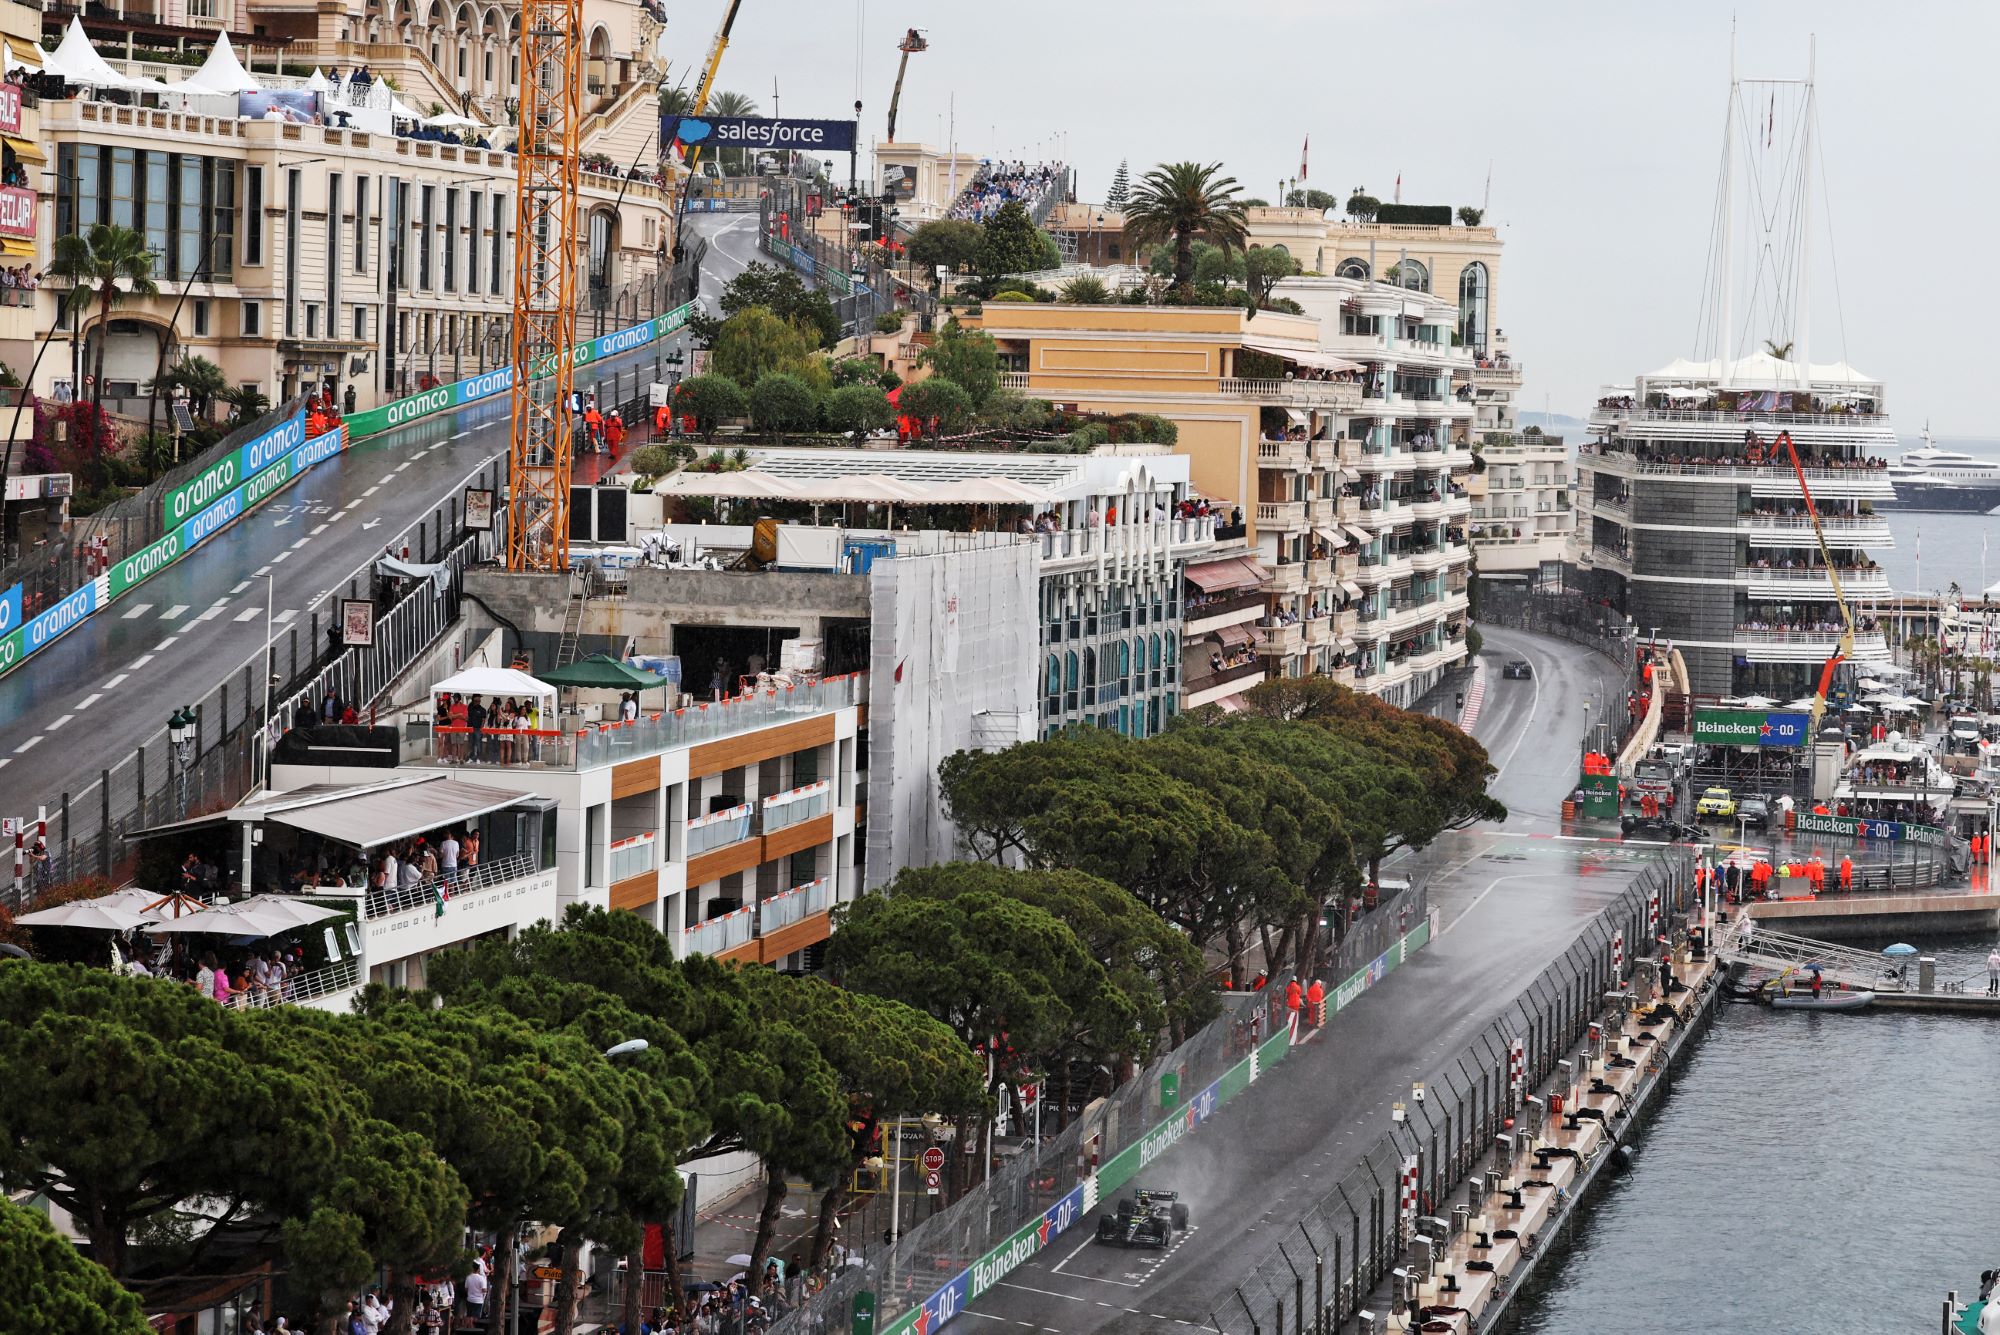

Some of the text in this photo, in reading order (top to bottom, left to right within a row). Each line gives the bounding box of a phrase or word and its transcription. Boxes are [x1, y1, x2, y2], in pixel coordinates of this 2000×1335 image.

[717, 121, 824, 146] salesforce
[603, 325, 649, 354] aramco
[658, 308, 687, 334] aramco
[387, 389, 449, 424] aramco
[250, 419, 299, 469] aramco
[297, 433, 337, 469] aramco
[174, 460, 234, 518] aramco
[247, 462, 287, 502] aramco
[193, 496, 236, 540] aramco
[125, 535, 178, 583] aramco
[33, 592, 87, 644] aramco
[1696, 721, 1757, 735] Heineken
[1797, 814, 1854, 834] Heineken
[925, 1155, 942, 1163] STOP
[1139, 1116, 1185, 1169] Heineken
[972, 1231, 1036, 1298] Heineken
